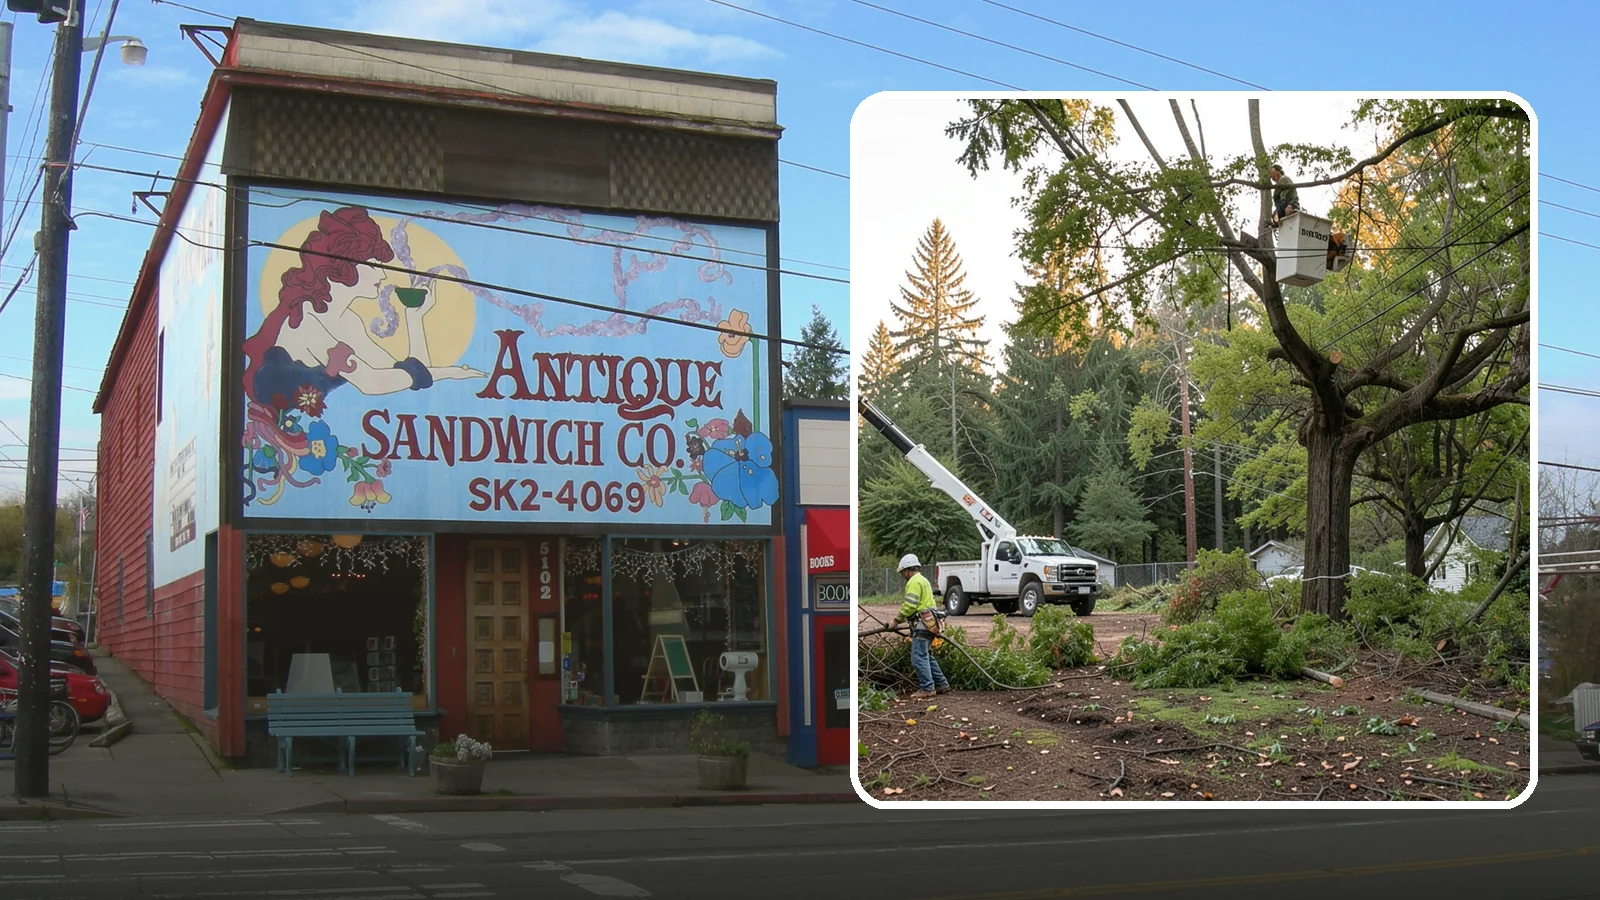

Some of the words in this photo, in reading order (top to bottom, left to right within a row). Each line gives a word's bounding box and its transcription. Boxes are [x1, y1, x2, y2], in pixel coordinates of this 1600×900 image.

[476, 329, 723, 420] ANTIQUE
[361, 409, 604, 467] SANDWICH
[617, 423, 685, 468] CO.
[468, 477, 645, 513] SK2-4069
[540, 541, 551, 600] 5102
[810, 555, 835, 569] BOOKS
